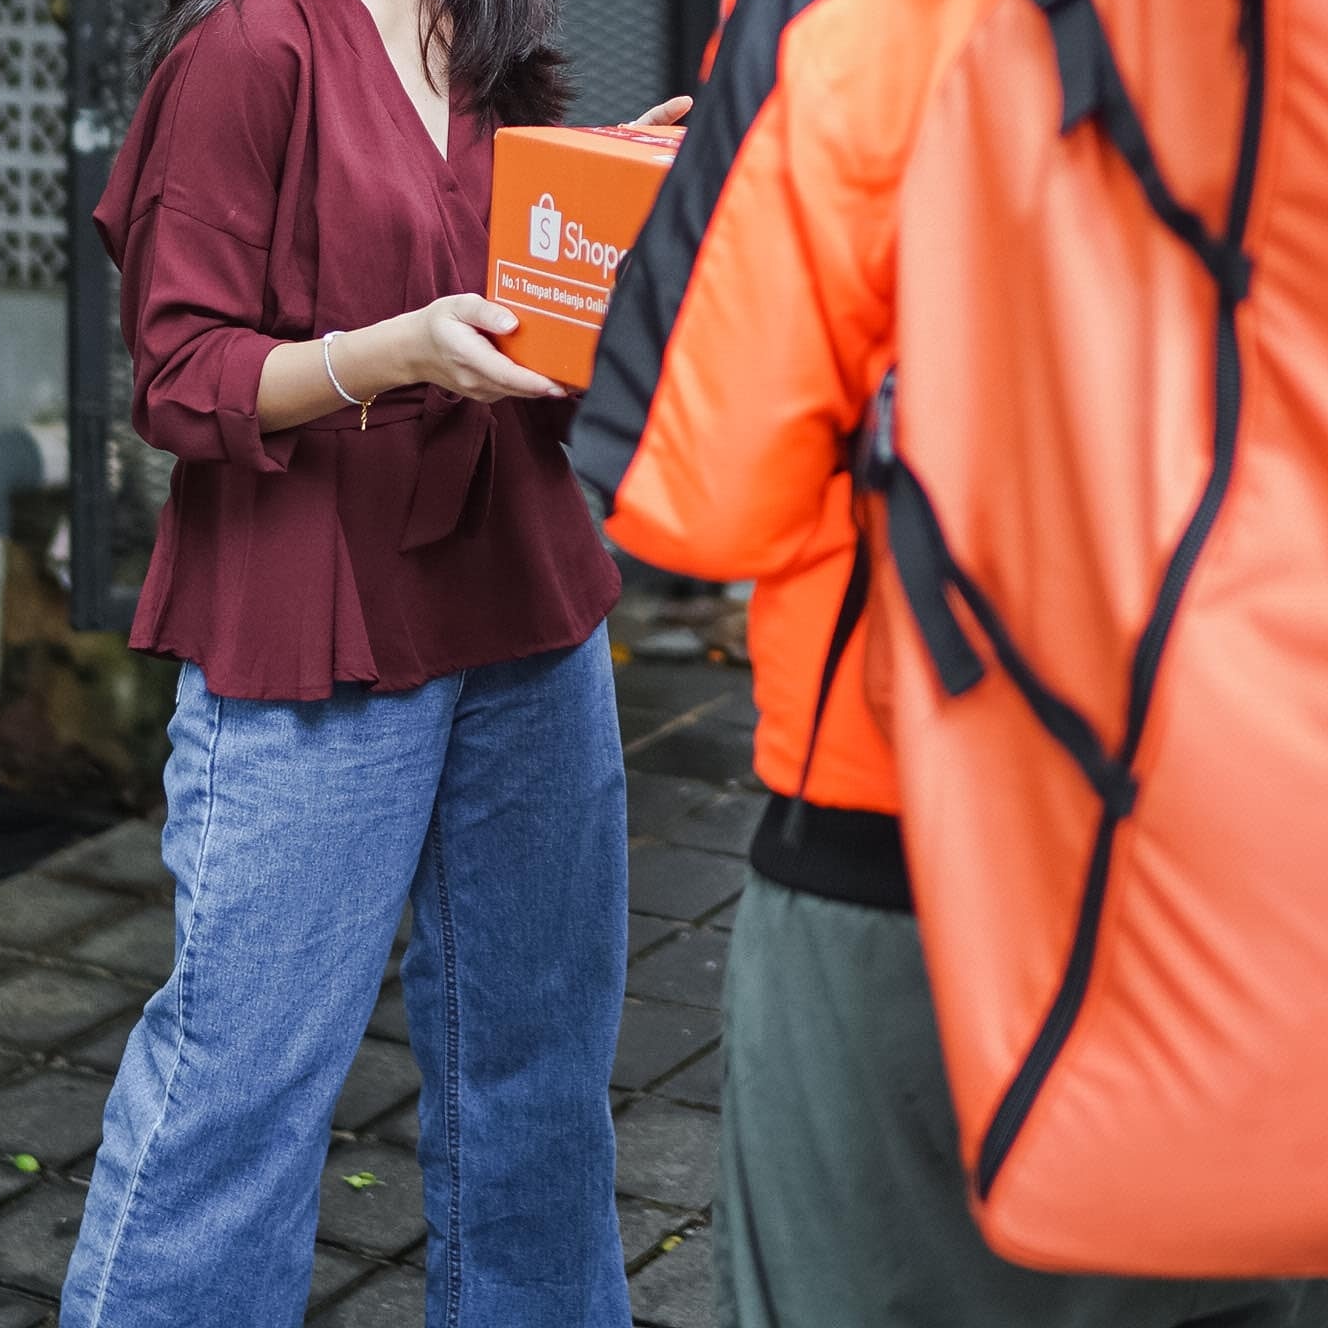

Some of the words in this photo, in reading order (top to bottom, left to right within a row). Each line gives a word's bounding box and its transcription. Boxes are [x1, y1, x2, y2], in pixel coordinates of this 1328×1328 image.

[501, 273, 520, 290] No.1
[522, 278, 552, 300] Tempat
[553, 287, 584, 310] Belanja
